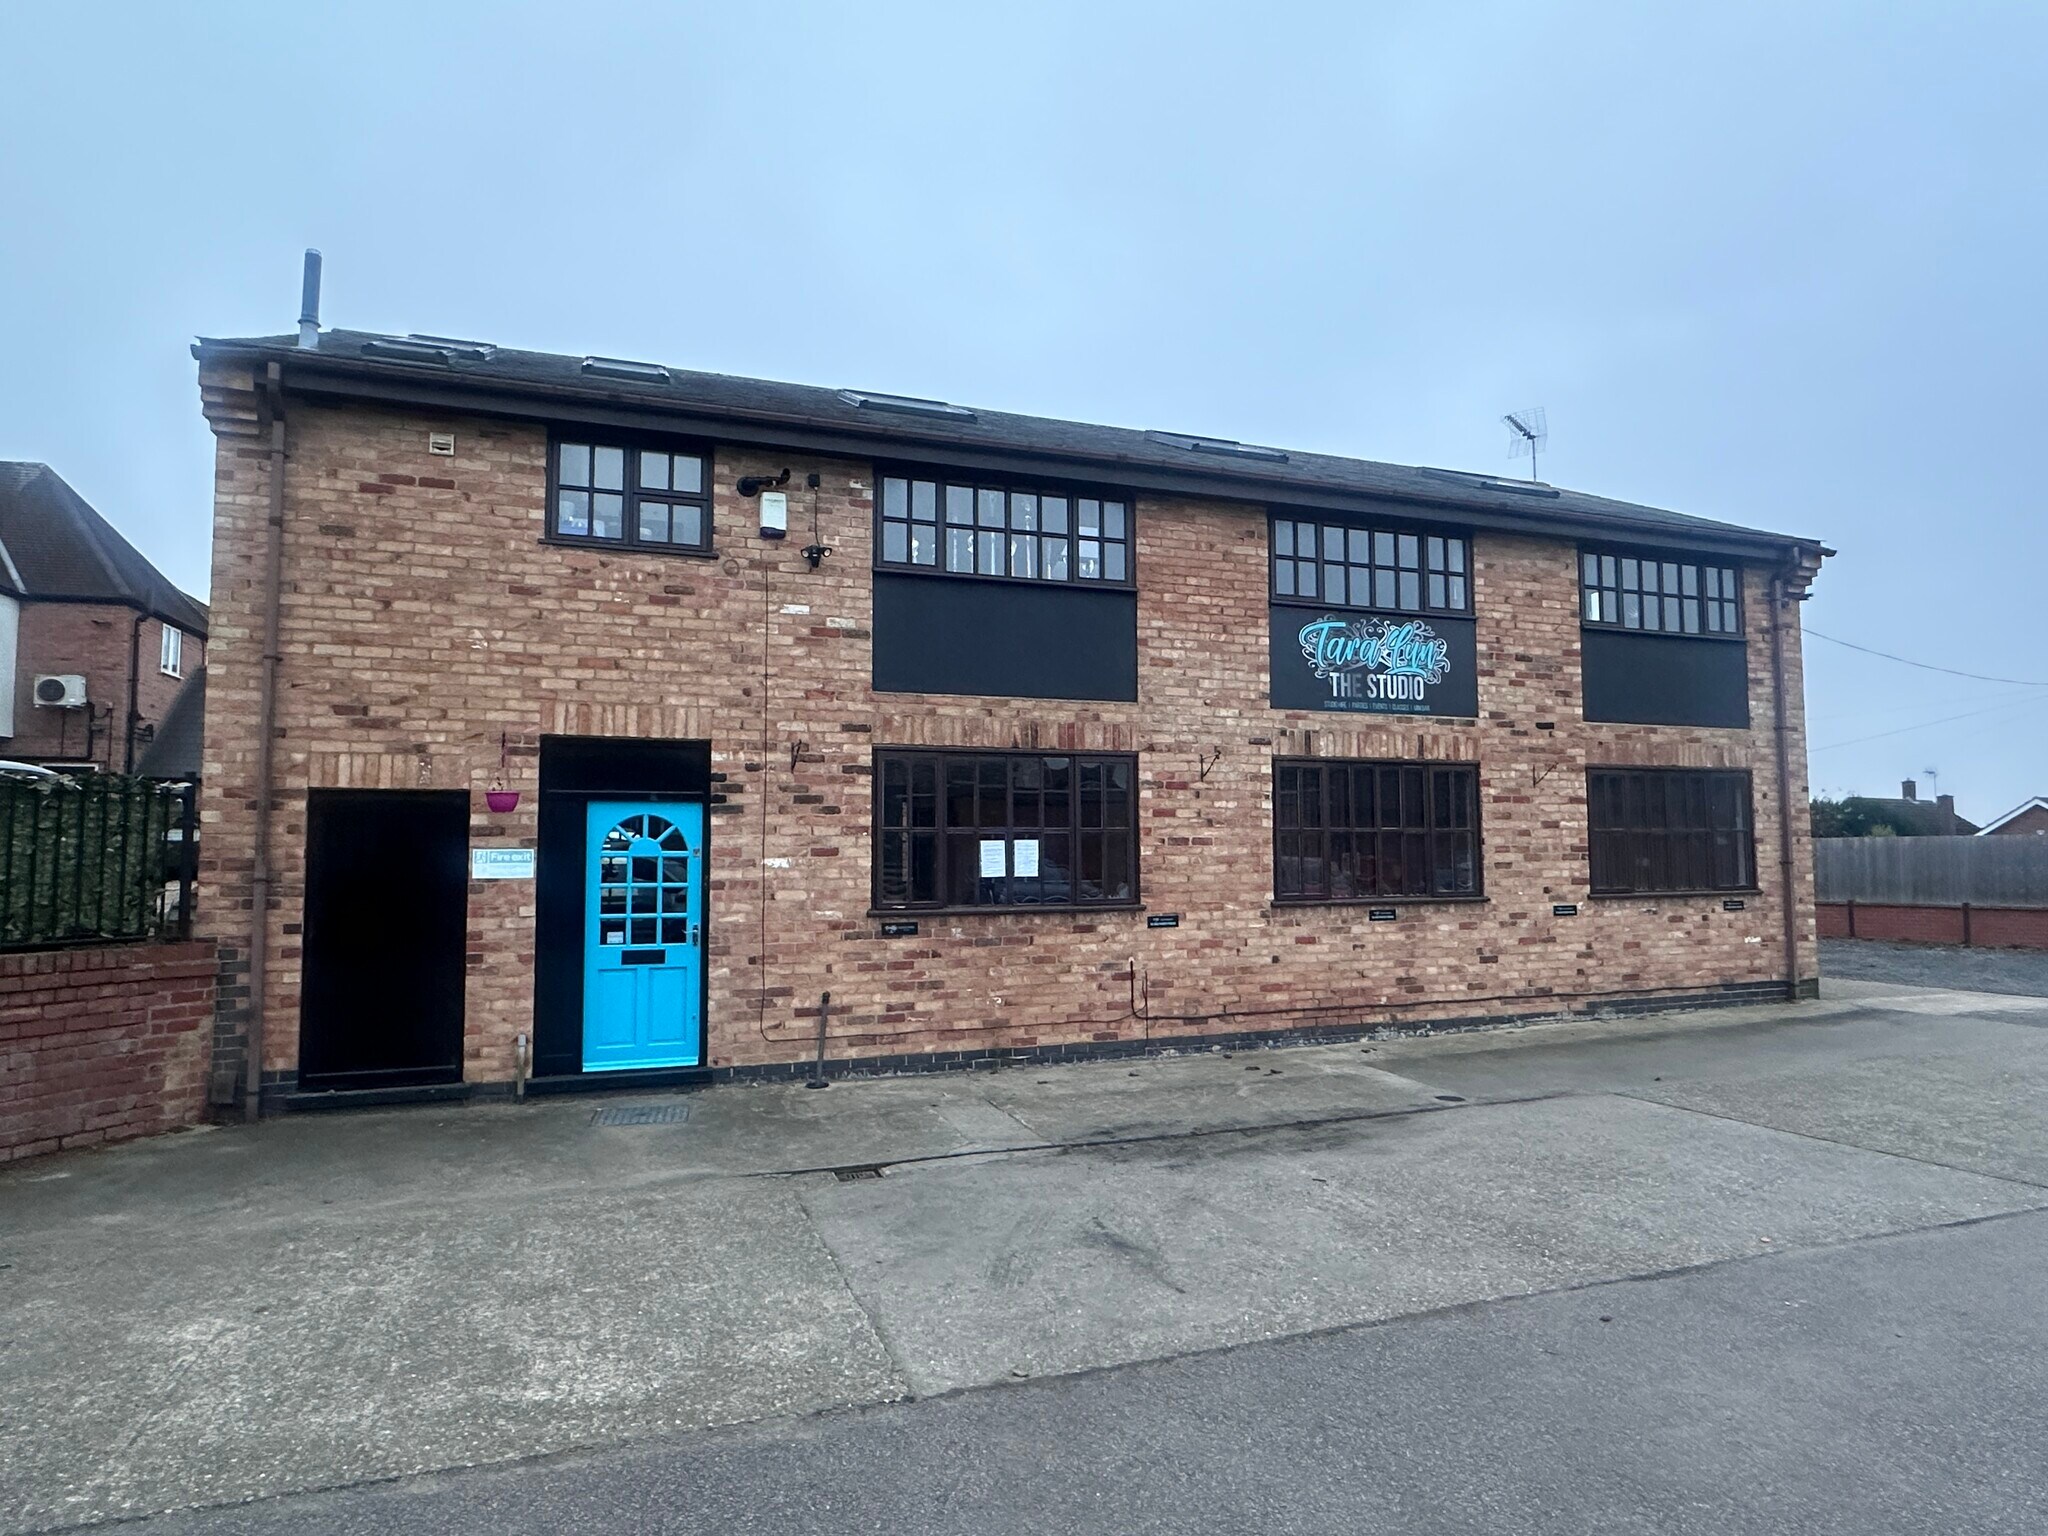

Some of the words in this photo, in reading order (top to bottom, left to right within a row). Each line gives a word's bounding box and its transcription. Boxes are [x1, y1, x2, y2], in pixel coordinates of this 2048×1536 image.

[1299, 620, 1381, 669] Tara
[1385, 622, 1437, 677] Lyn
[1330, 672, 1362, 697] THE
[1367, 673, 1425, 701] STUDIO
[490, 852, 510, 861] Fire
[512, 852, 531, 861] exit
